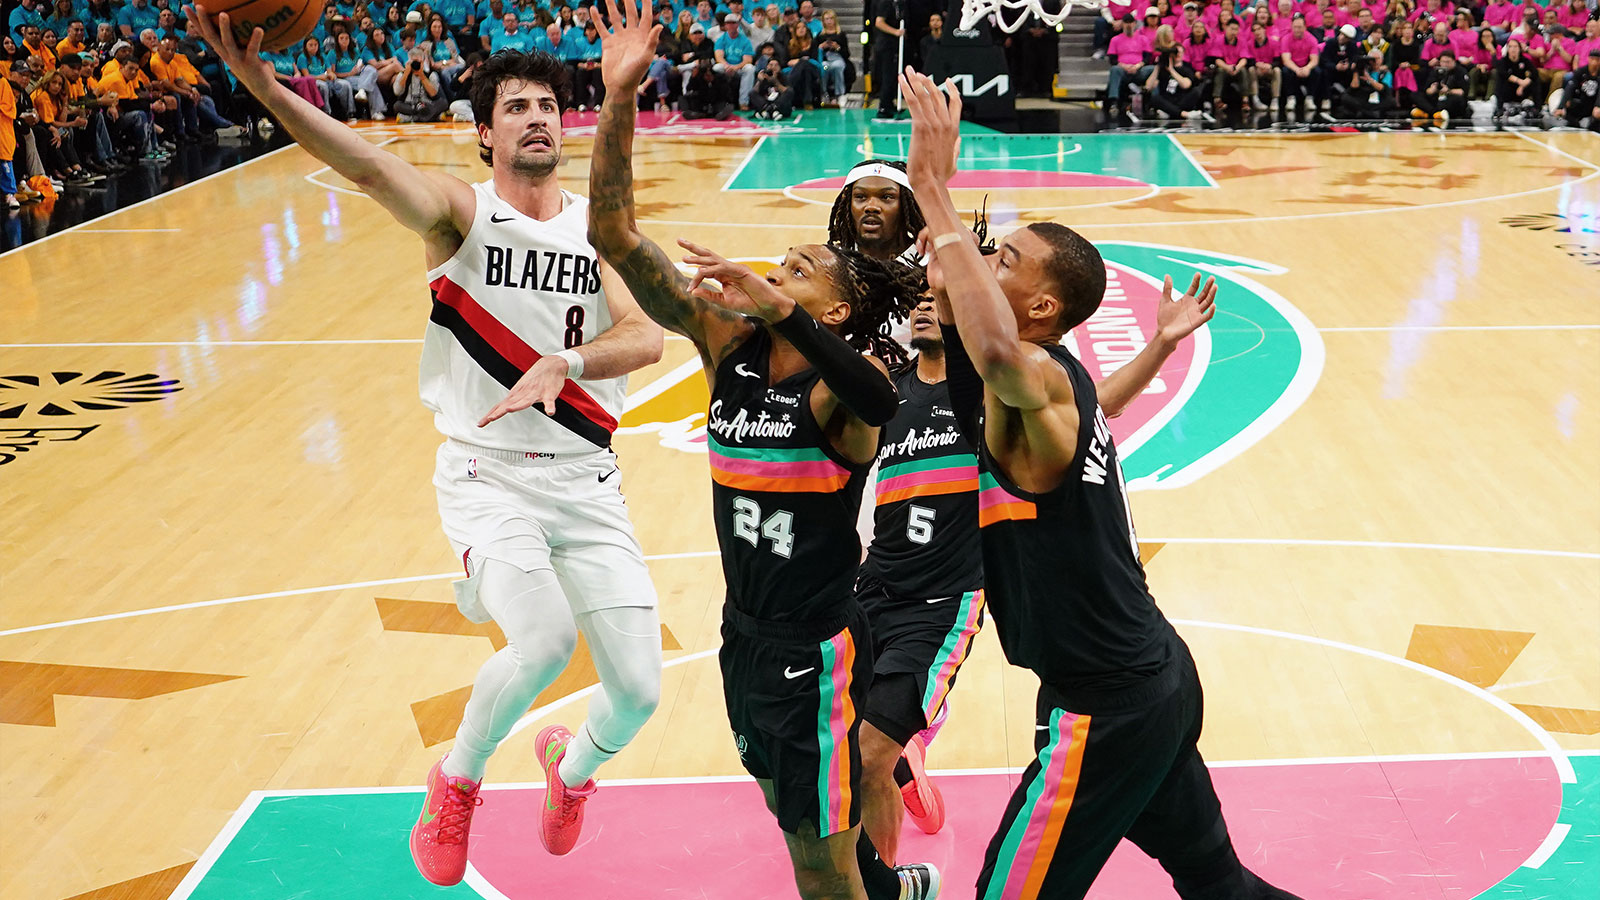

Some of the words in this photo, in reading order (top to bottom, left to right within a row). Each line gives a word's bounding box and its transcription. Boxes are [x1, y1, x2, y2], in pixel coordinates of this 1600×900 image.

[484, 244, 602, 295] BLAZERS
[564, 305, 585, 350] 8
[769, 392, 798, 406] LEDGER
[933, 408, 955, 418] LEDGE
[725, 407, 797, 444] Antonio
[877, 442, 896, 467] an
[897, 426, 961, 457] Antonio
[732, 495, 796, 560] 24
[906, 503, 937, 546] 5
